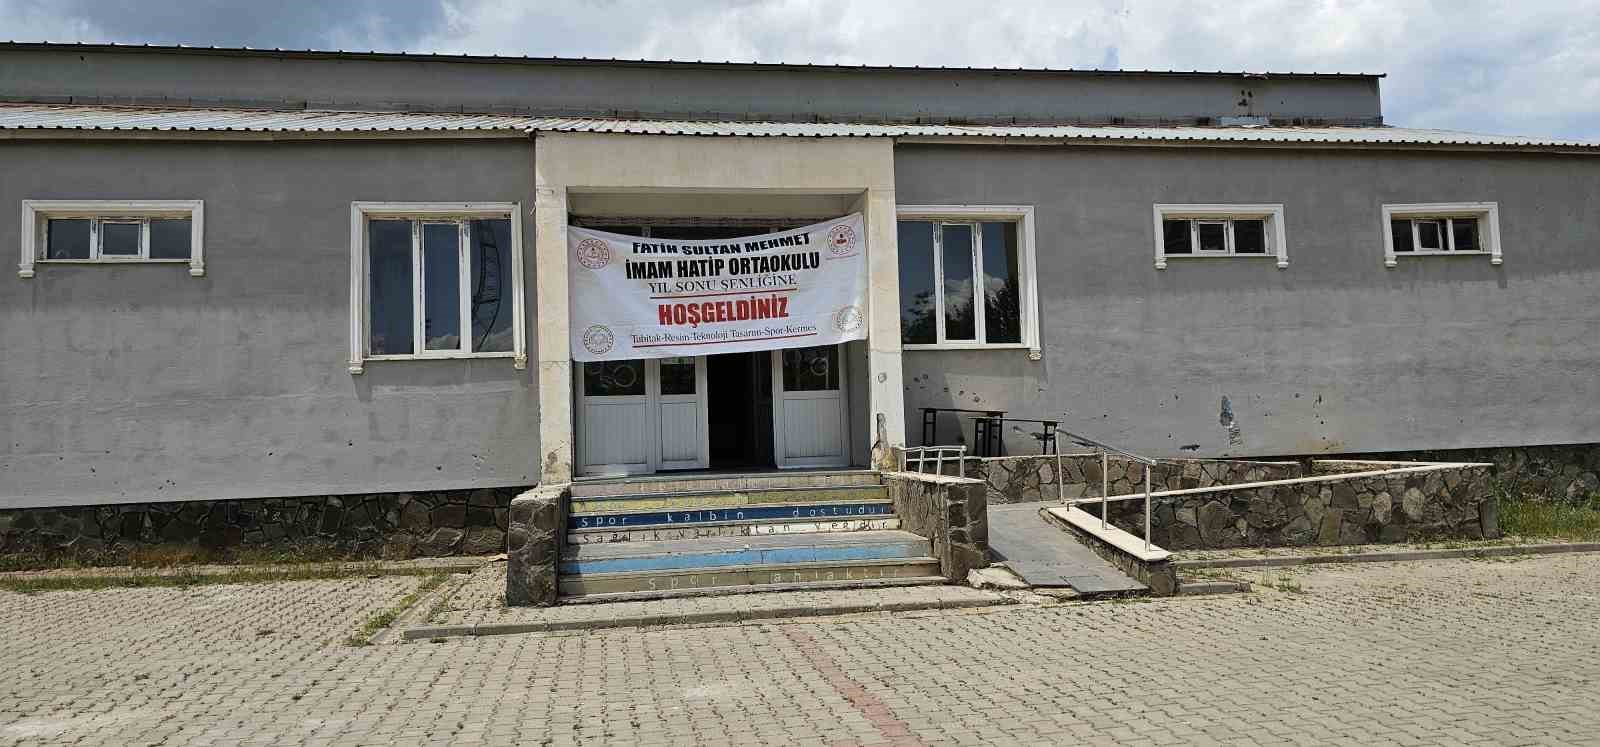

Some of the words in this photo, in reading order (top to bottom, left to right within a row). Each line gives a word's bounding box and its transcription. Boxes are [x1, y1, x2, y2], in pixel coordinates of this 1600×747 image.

[633, 242, 678, 254] FATİH
[681, 243, 741, 255] SULTAN
[744, 232, 810, 252] MEHMET
[625, 259, 673, 279] İMAM
[677, 256, 725, 278] HATİP
[728, 252, 820, 276] ORTAOKULU
[648, 282, 672, 293] YIL
[676, 279, 716, 292] SONU
[658, 295, 789, 328] HOŞGELDİNİZ
[581, 516, 627, 528] spor
[667, 511, 744, 522] kalbin
[793, 504, 885, 517] dostudur
